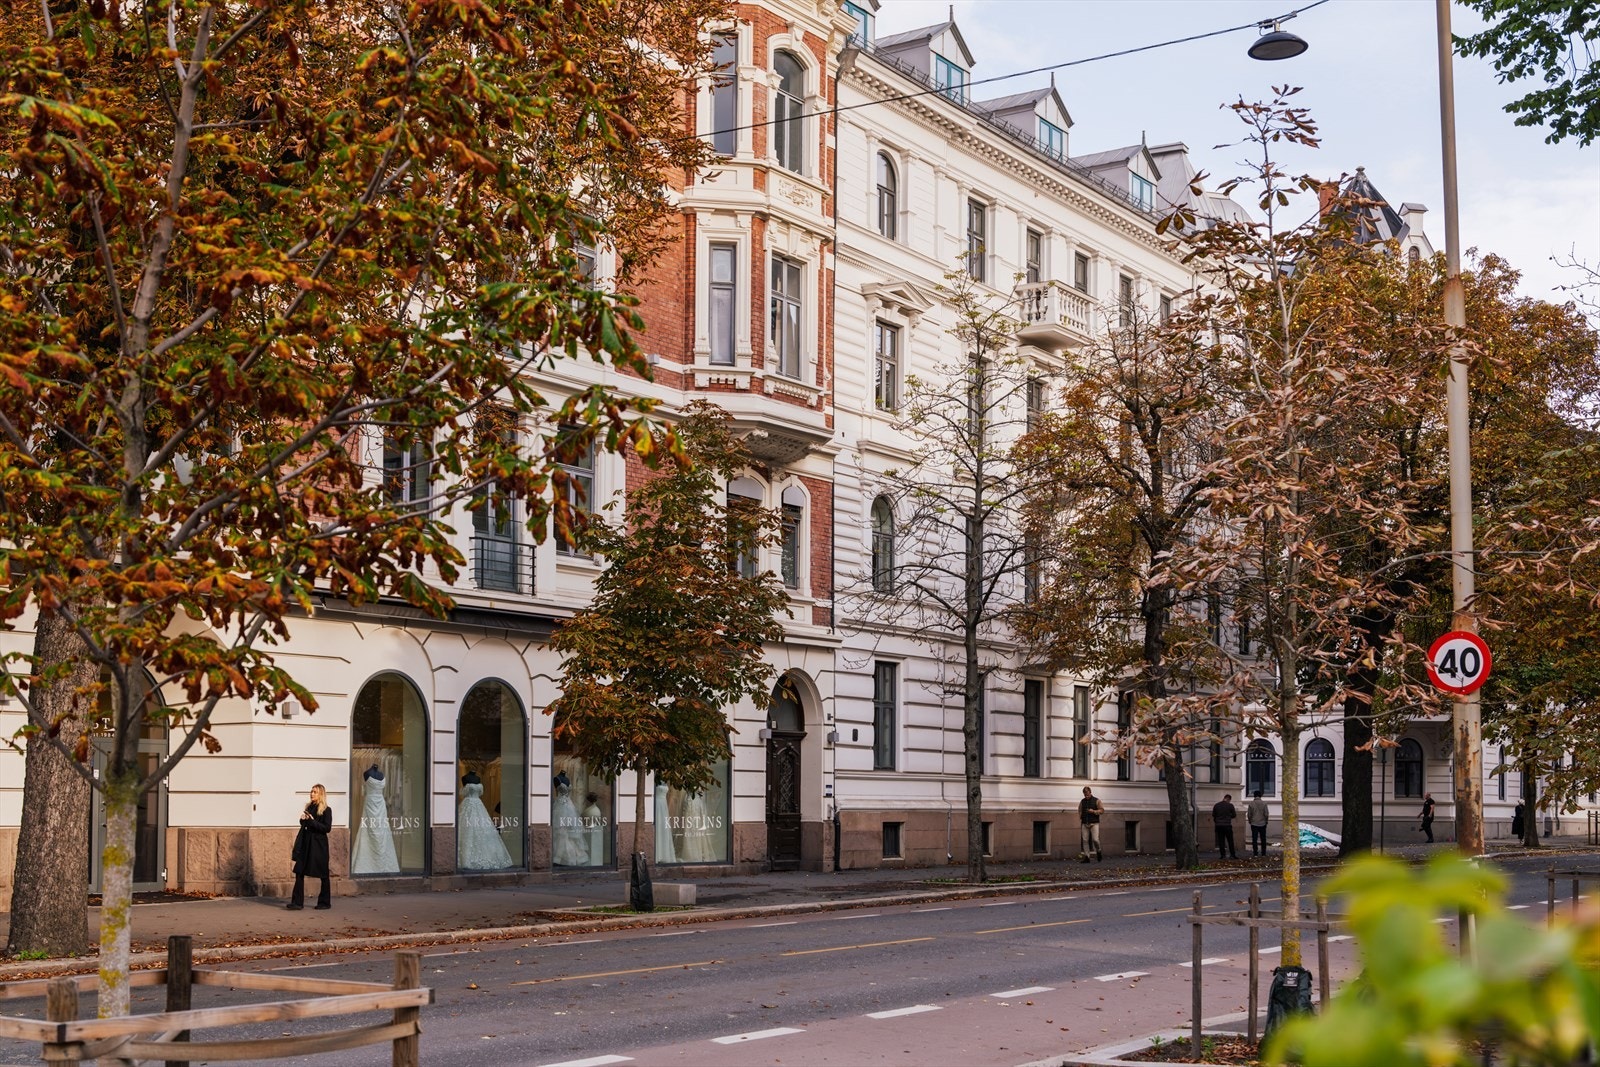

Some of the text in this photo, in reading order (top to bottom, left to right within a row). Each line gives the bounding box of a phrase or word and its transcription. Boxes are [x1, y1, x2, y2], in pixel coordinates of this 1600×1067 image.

[1438, 647, 1481, 678] 40
[360, 816, 420, 829] KRISTINS
[559, 815, 608, 828] KRISTINS
[664, 815, 722, 830] KRISTINS
